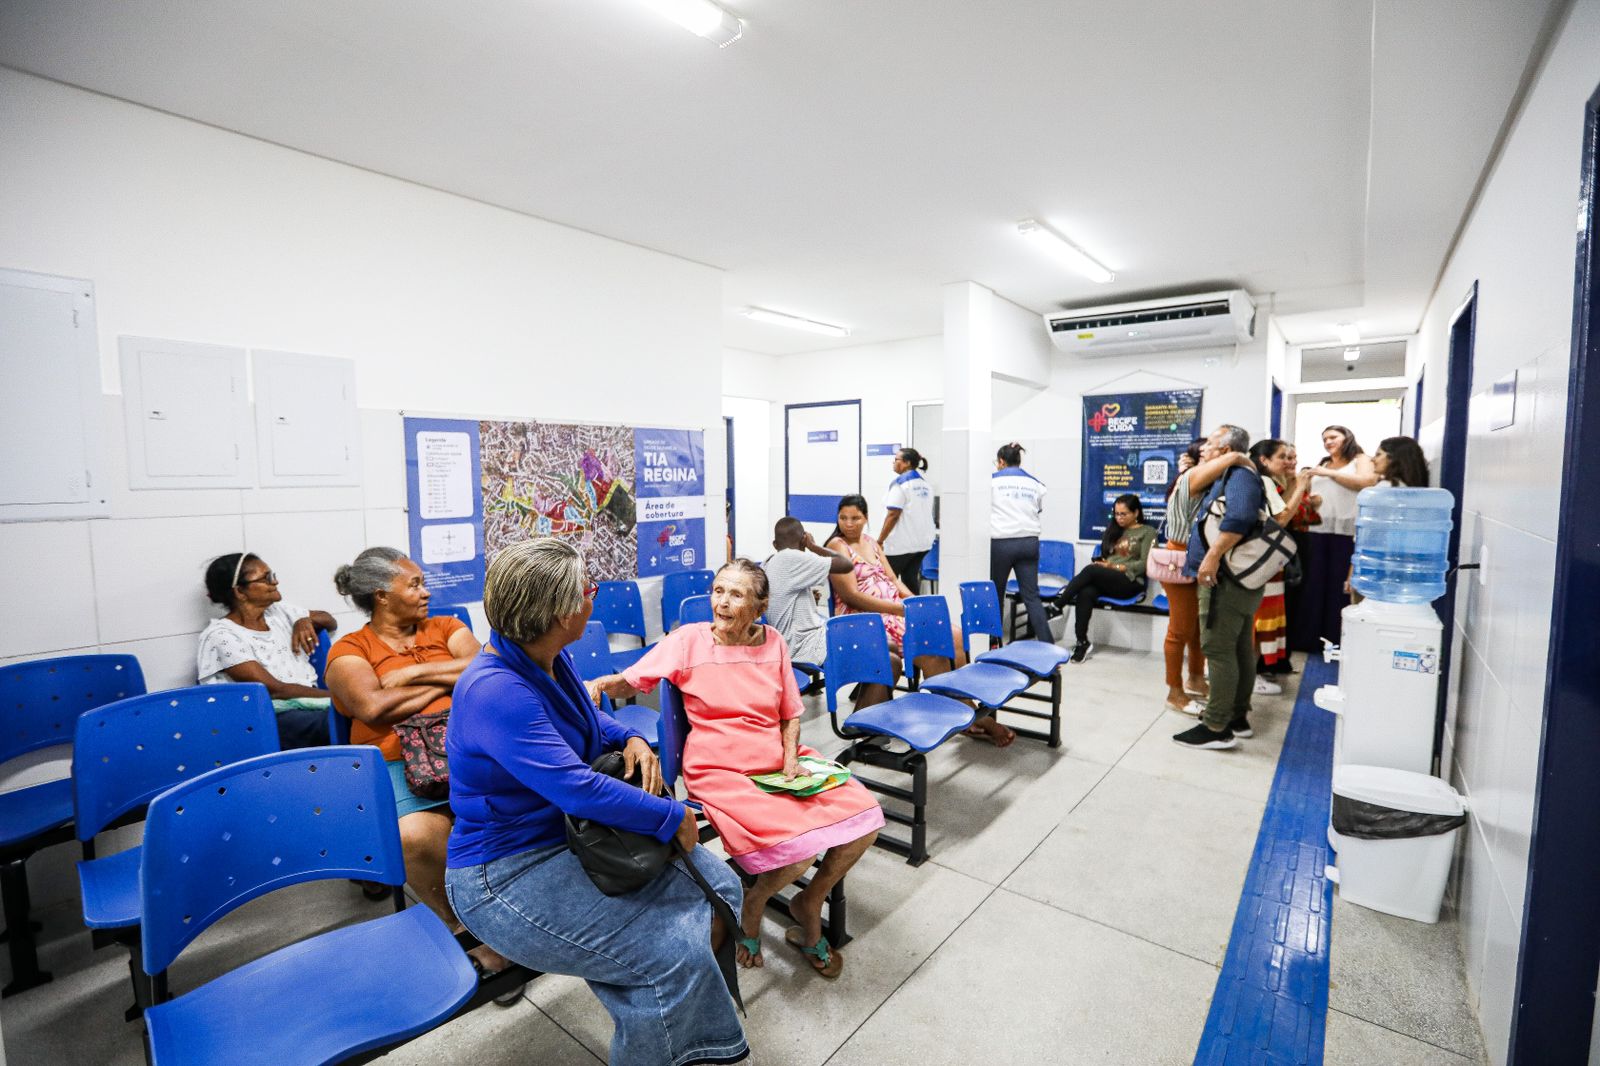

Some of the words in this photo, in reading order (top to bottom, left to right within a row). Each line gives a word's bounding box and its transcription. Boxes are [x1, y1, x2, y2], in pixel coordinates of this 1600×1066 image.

[1107, 416, 1138, 425] RECIFE
[1107, 424, 1135, 432] CUIDA
[643, 452, 668, 467] TIA
[643, 467, 698, 482] REGINA
[645, 500, 664, 510] Área
[645, 511, 684, 519] cobertura
